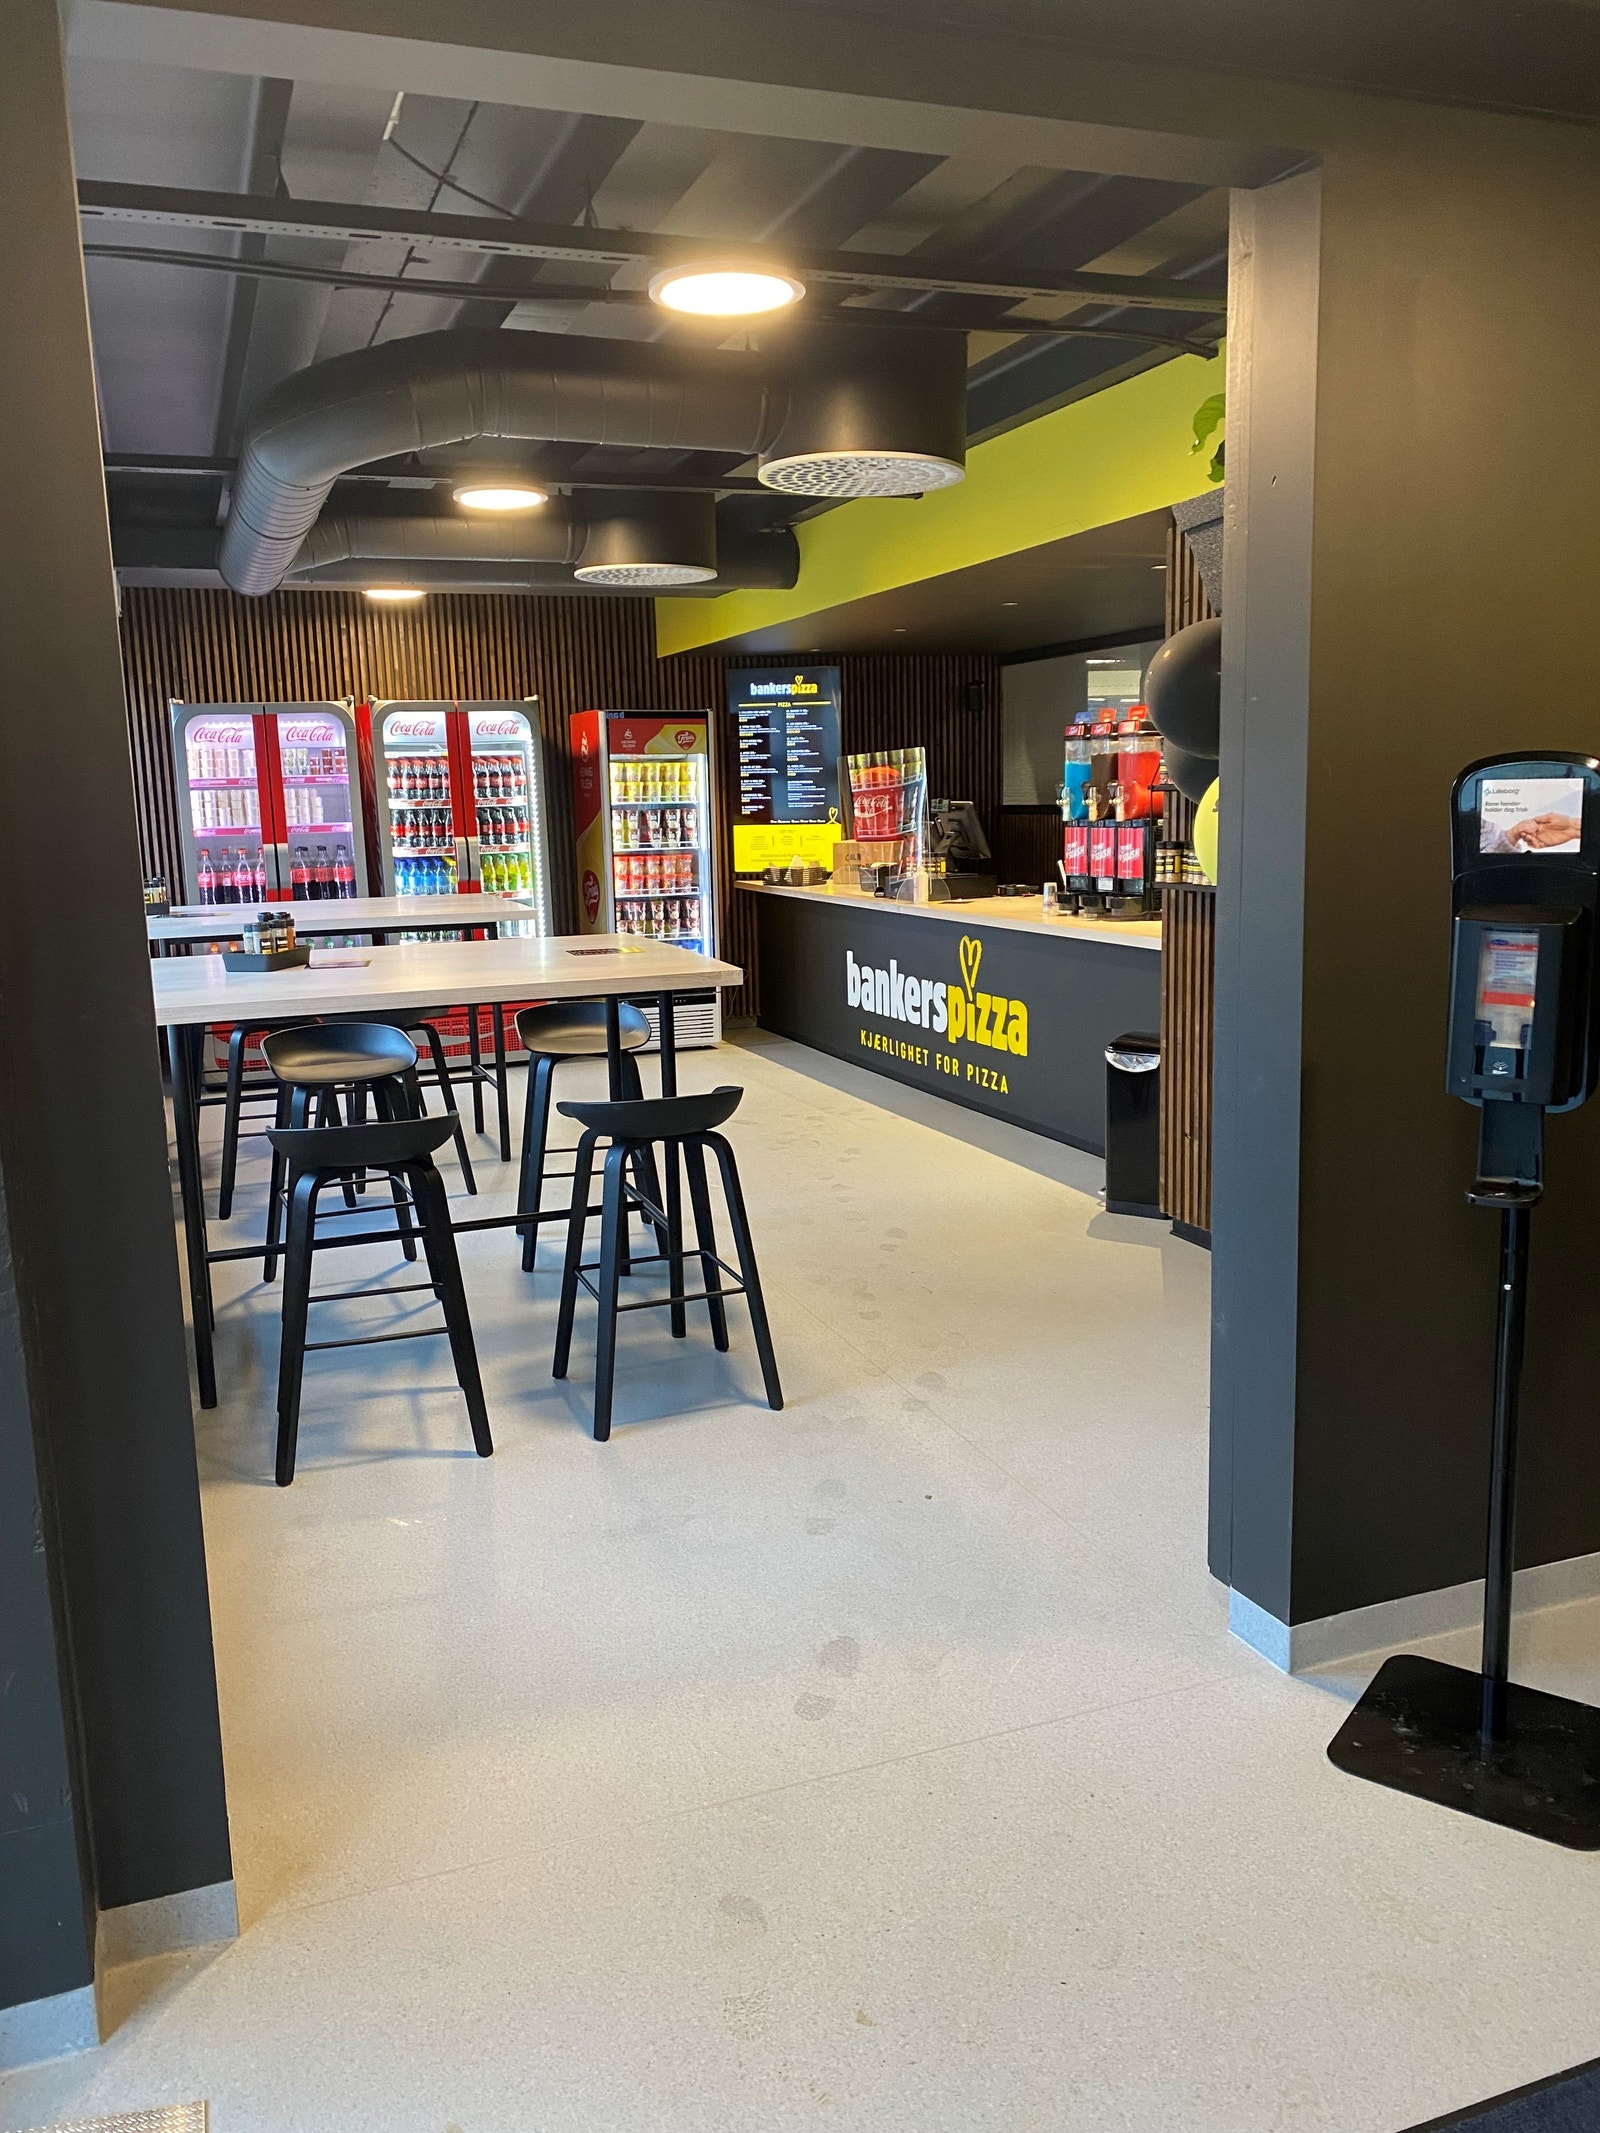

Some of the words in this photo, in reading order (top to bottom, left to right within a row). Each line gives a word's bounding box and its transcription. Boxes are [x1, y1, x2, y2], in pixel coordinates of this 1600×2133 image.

[750, 679, 818, 696] bankerspizza
[193, 726, 245, 744] Coca-Cola
[285, 725, 335, 742] Coca-Cola
[390, 720, 437, 736] Coca-Cola
[476, 719, 521, 736] Coca-Cola
[846, 950, 1028, 1057] bankerspizza
[860, 1029, 929, 1067] KJÆRLIGHET
[935, 1053, 959, 1077] FOR
[967, 1063, 1009, 1094] PIZZA
